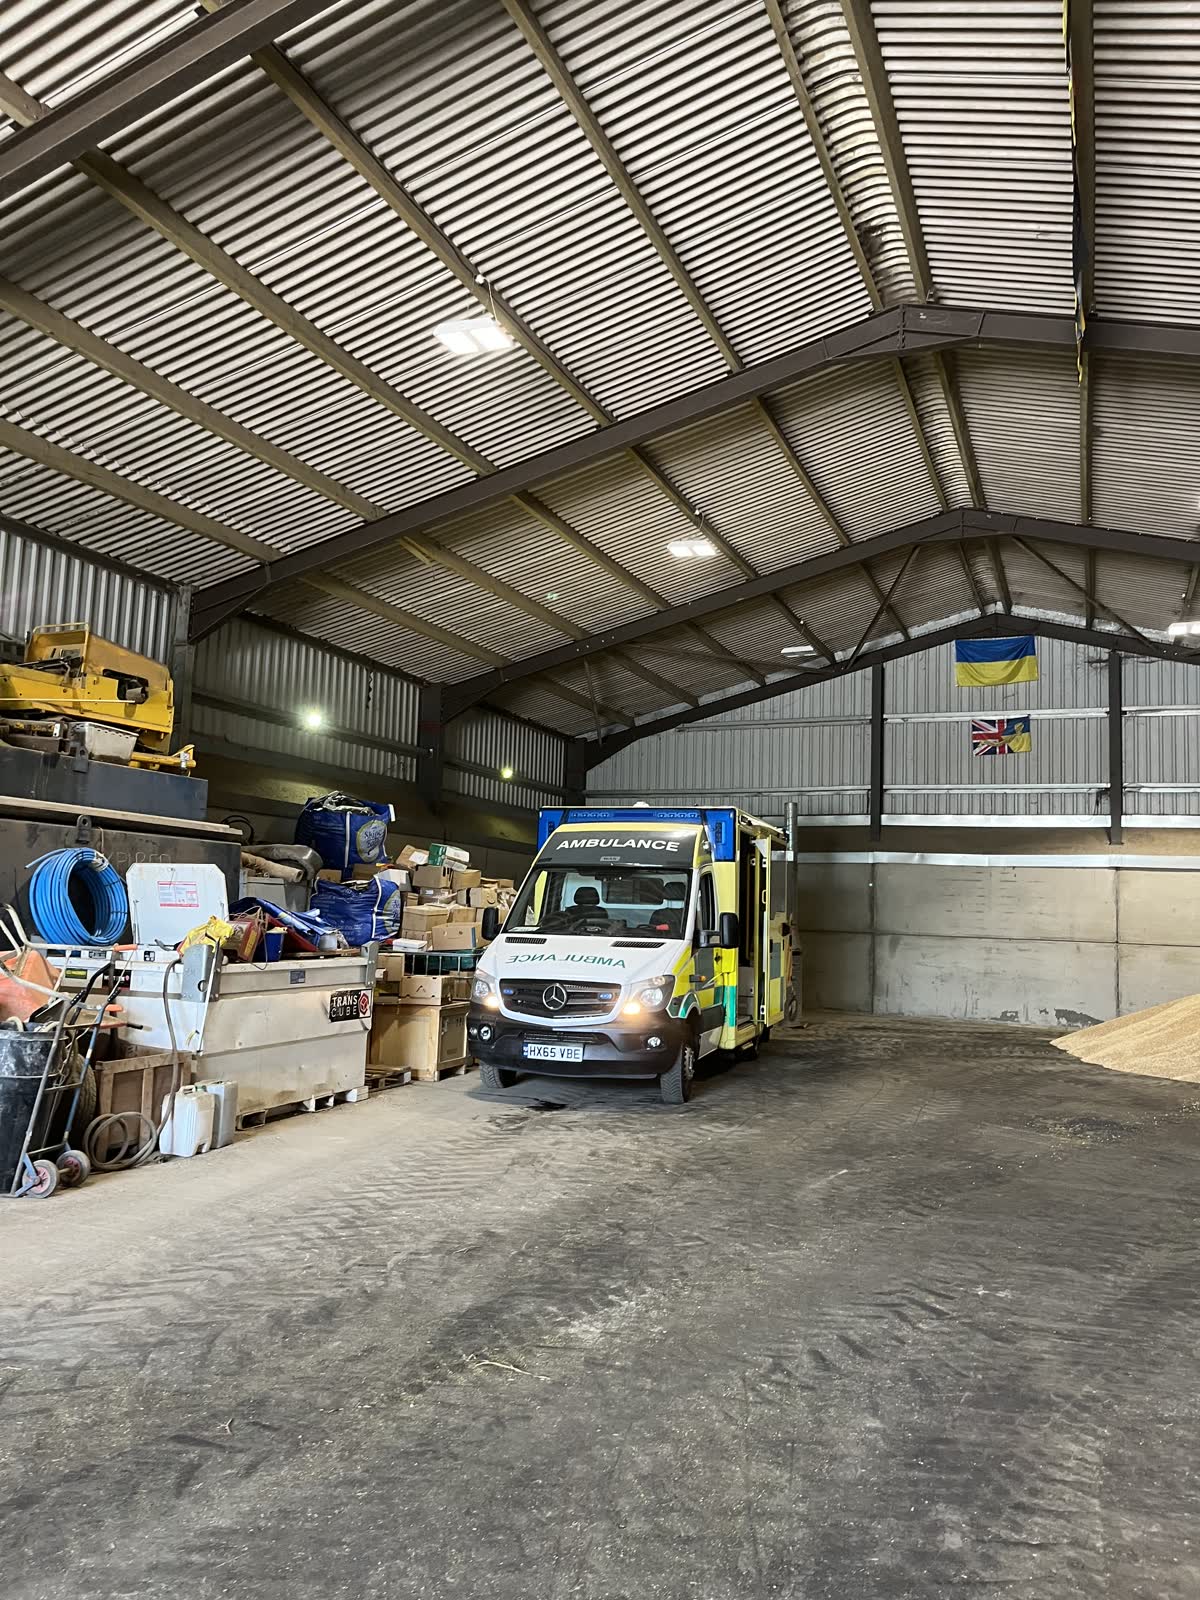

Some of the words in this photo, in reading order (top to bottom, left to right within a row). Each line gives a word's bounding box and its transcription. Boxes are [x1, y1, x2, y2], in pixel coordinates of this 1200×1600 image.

[556, 839, 681, 852] AMBULANCE
[331, 995, 358, 1008] TRANS
[330, 1005, 358, 1018] CUBE
[529, 1045, 557, 1058] HX65
[560, 1047, 581, 1060] VBE
